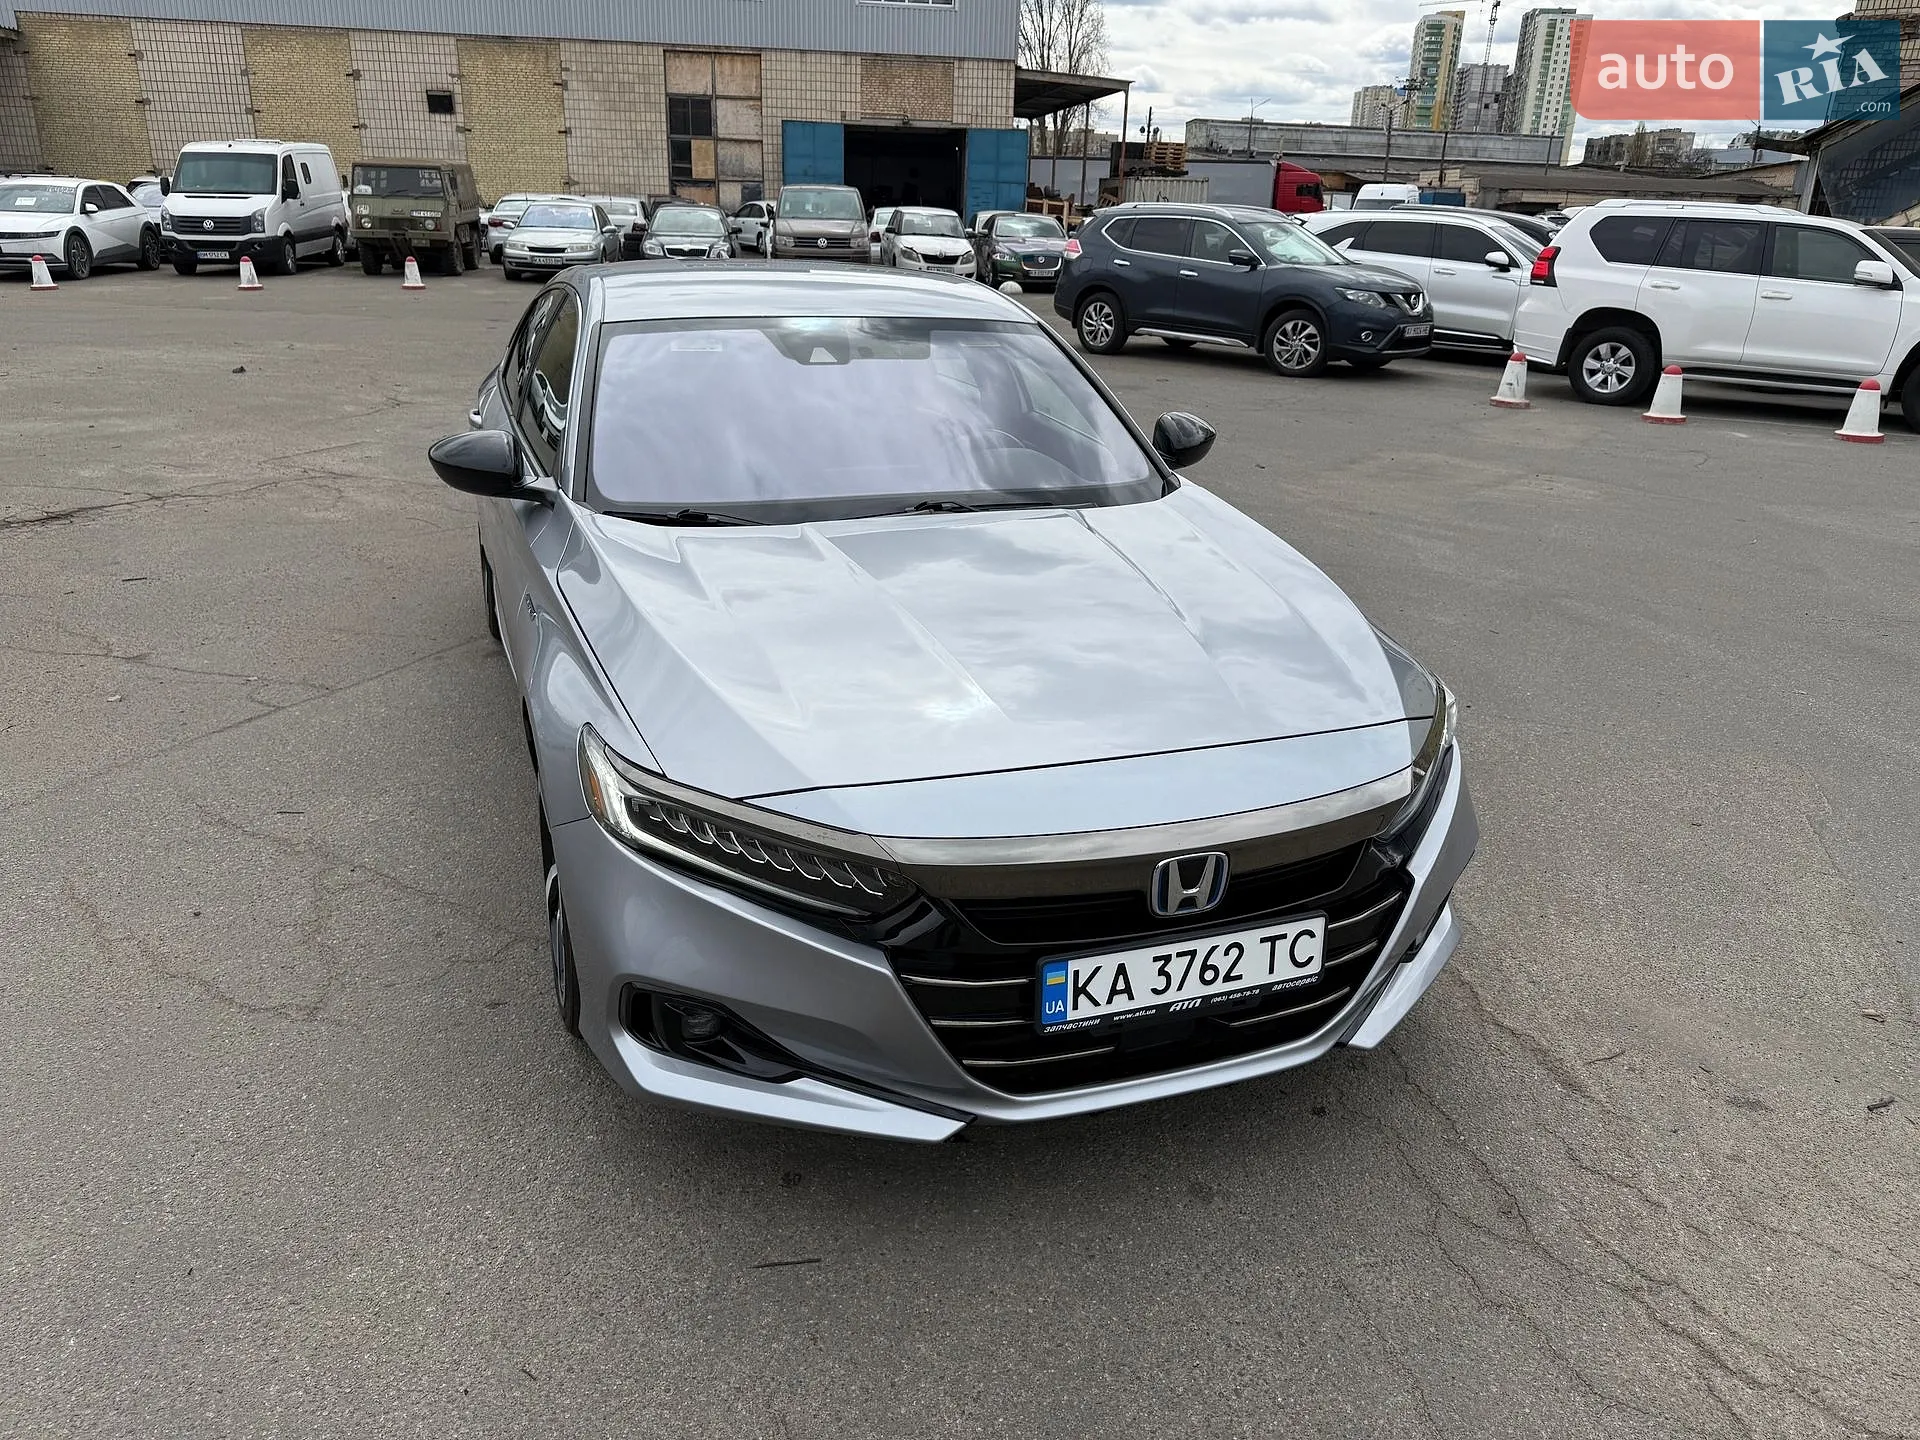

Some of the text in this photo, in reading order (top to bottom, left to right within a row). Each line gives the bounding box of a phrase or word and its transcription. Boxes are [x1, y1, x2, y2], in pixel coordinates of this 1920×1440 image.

[1072, 928, 1317, 1010] KA 3762 TC
[1271, 975, 1318, 991] автосервіс
[1045, 1000, 1065, 1014] UA
[1113, 1009, 1156, 1021] www.atl.ua
[1044, 1018, 1101, 1033] запчастини
